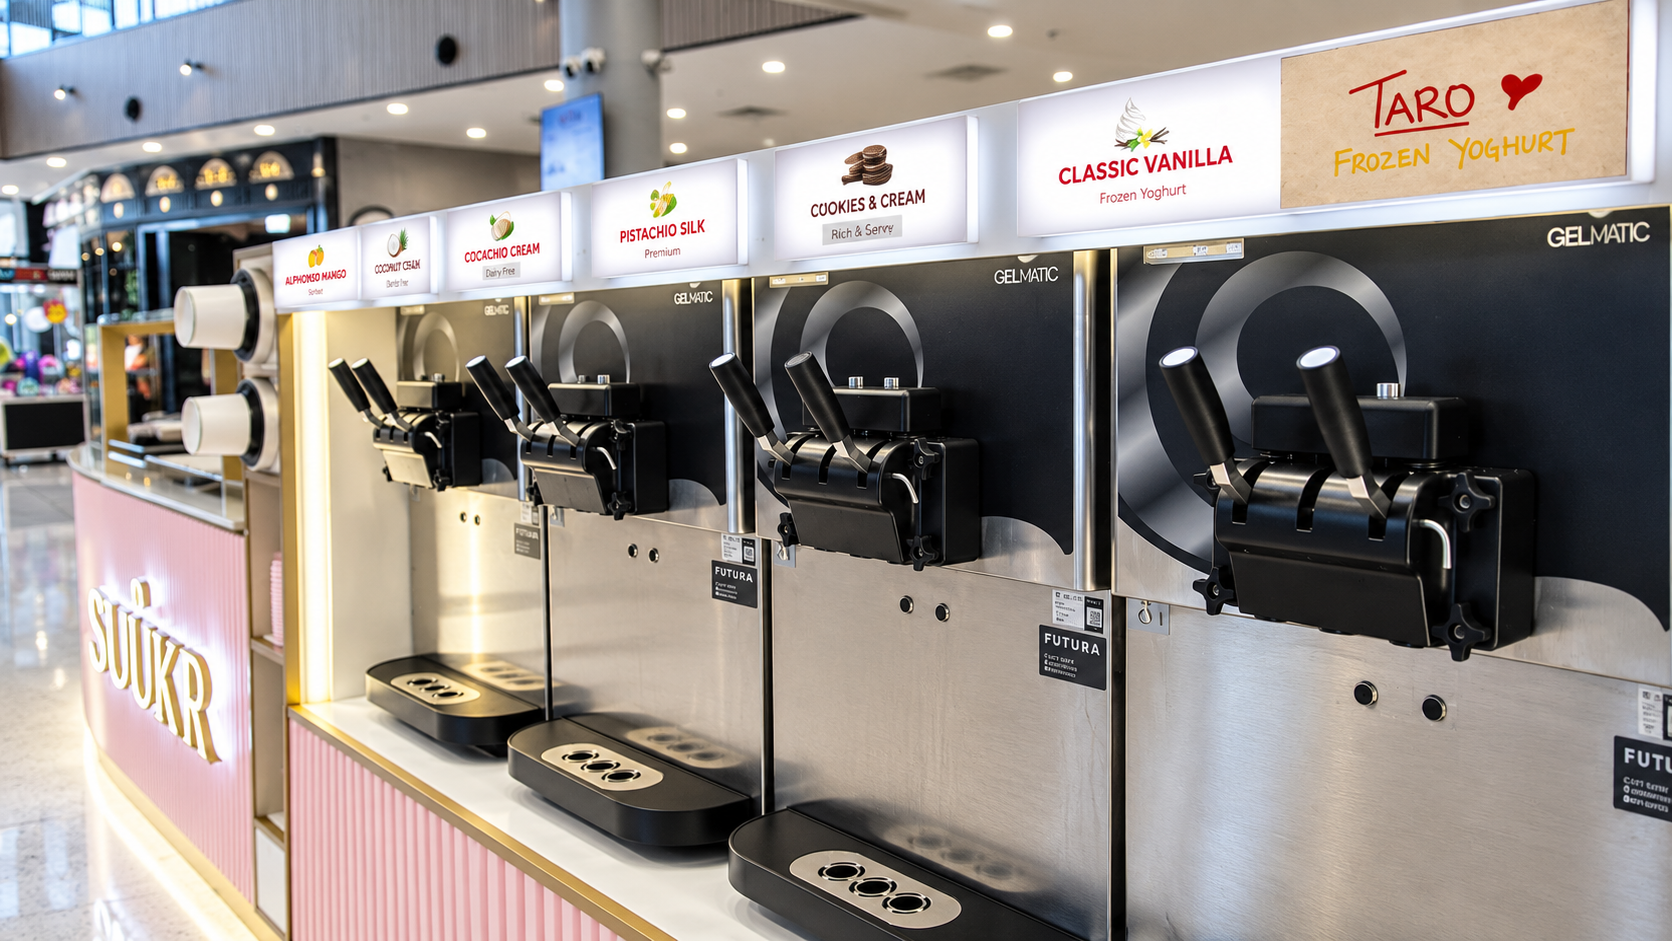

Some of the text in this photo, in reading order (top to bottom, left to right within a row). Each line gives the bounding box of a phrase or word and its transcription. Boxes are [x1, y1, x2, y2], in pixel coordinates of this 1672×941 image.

[1349, 70, 1475, 128] TARO
[1333, 128, 1576, 177] FROZEN YOGHURT
[1058, 145, 1233, 185] CLASSIC VANILLA
[868, 195, 878, 210] &
[880, 188, 926, 208] CREAM
[1099, 184, 1187, 204] Frozen Yoghurt
[620, 219, 705, 243] PISTACHIO SILK
[831, 227, 852, 240] Rich
[854, 225, 862, 237] &
[1547, 221, 1650, 248] GELMATIC
[464, 242, 540, 263] COCACHIO CREAM
[644, 247, 681, 259] Premium
[994, 266, 1059, 285] GELMATIC
[673, 290, 713, 305] GELMATIC
[715, 566, 754, 583] FUTURA
[1044, 632, 1100, 656] FUTURA
